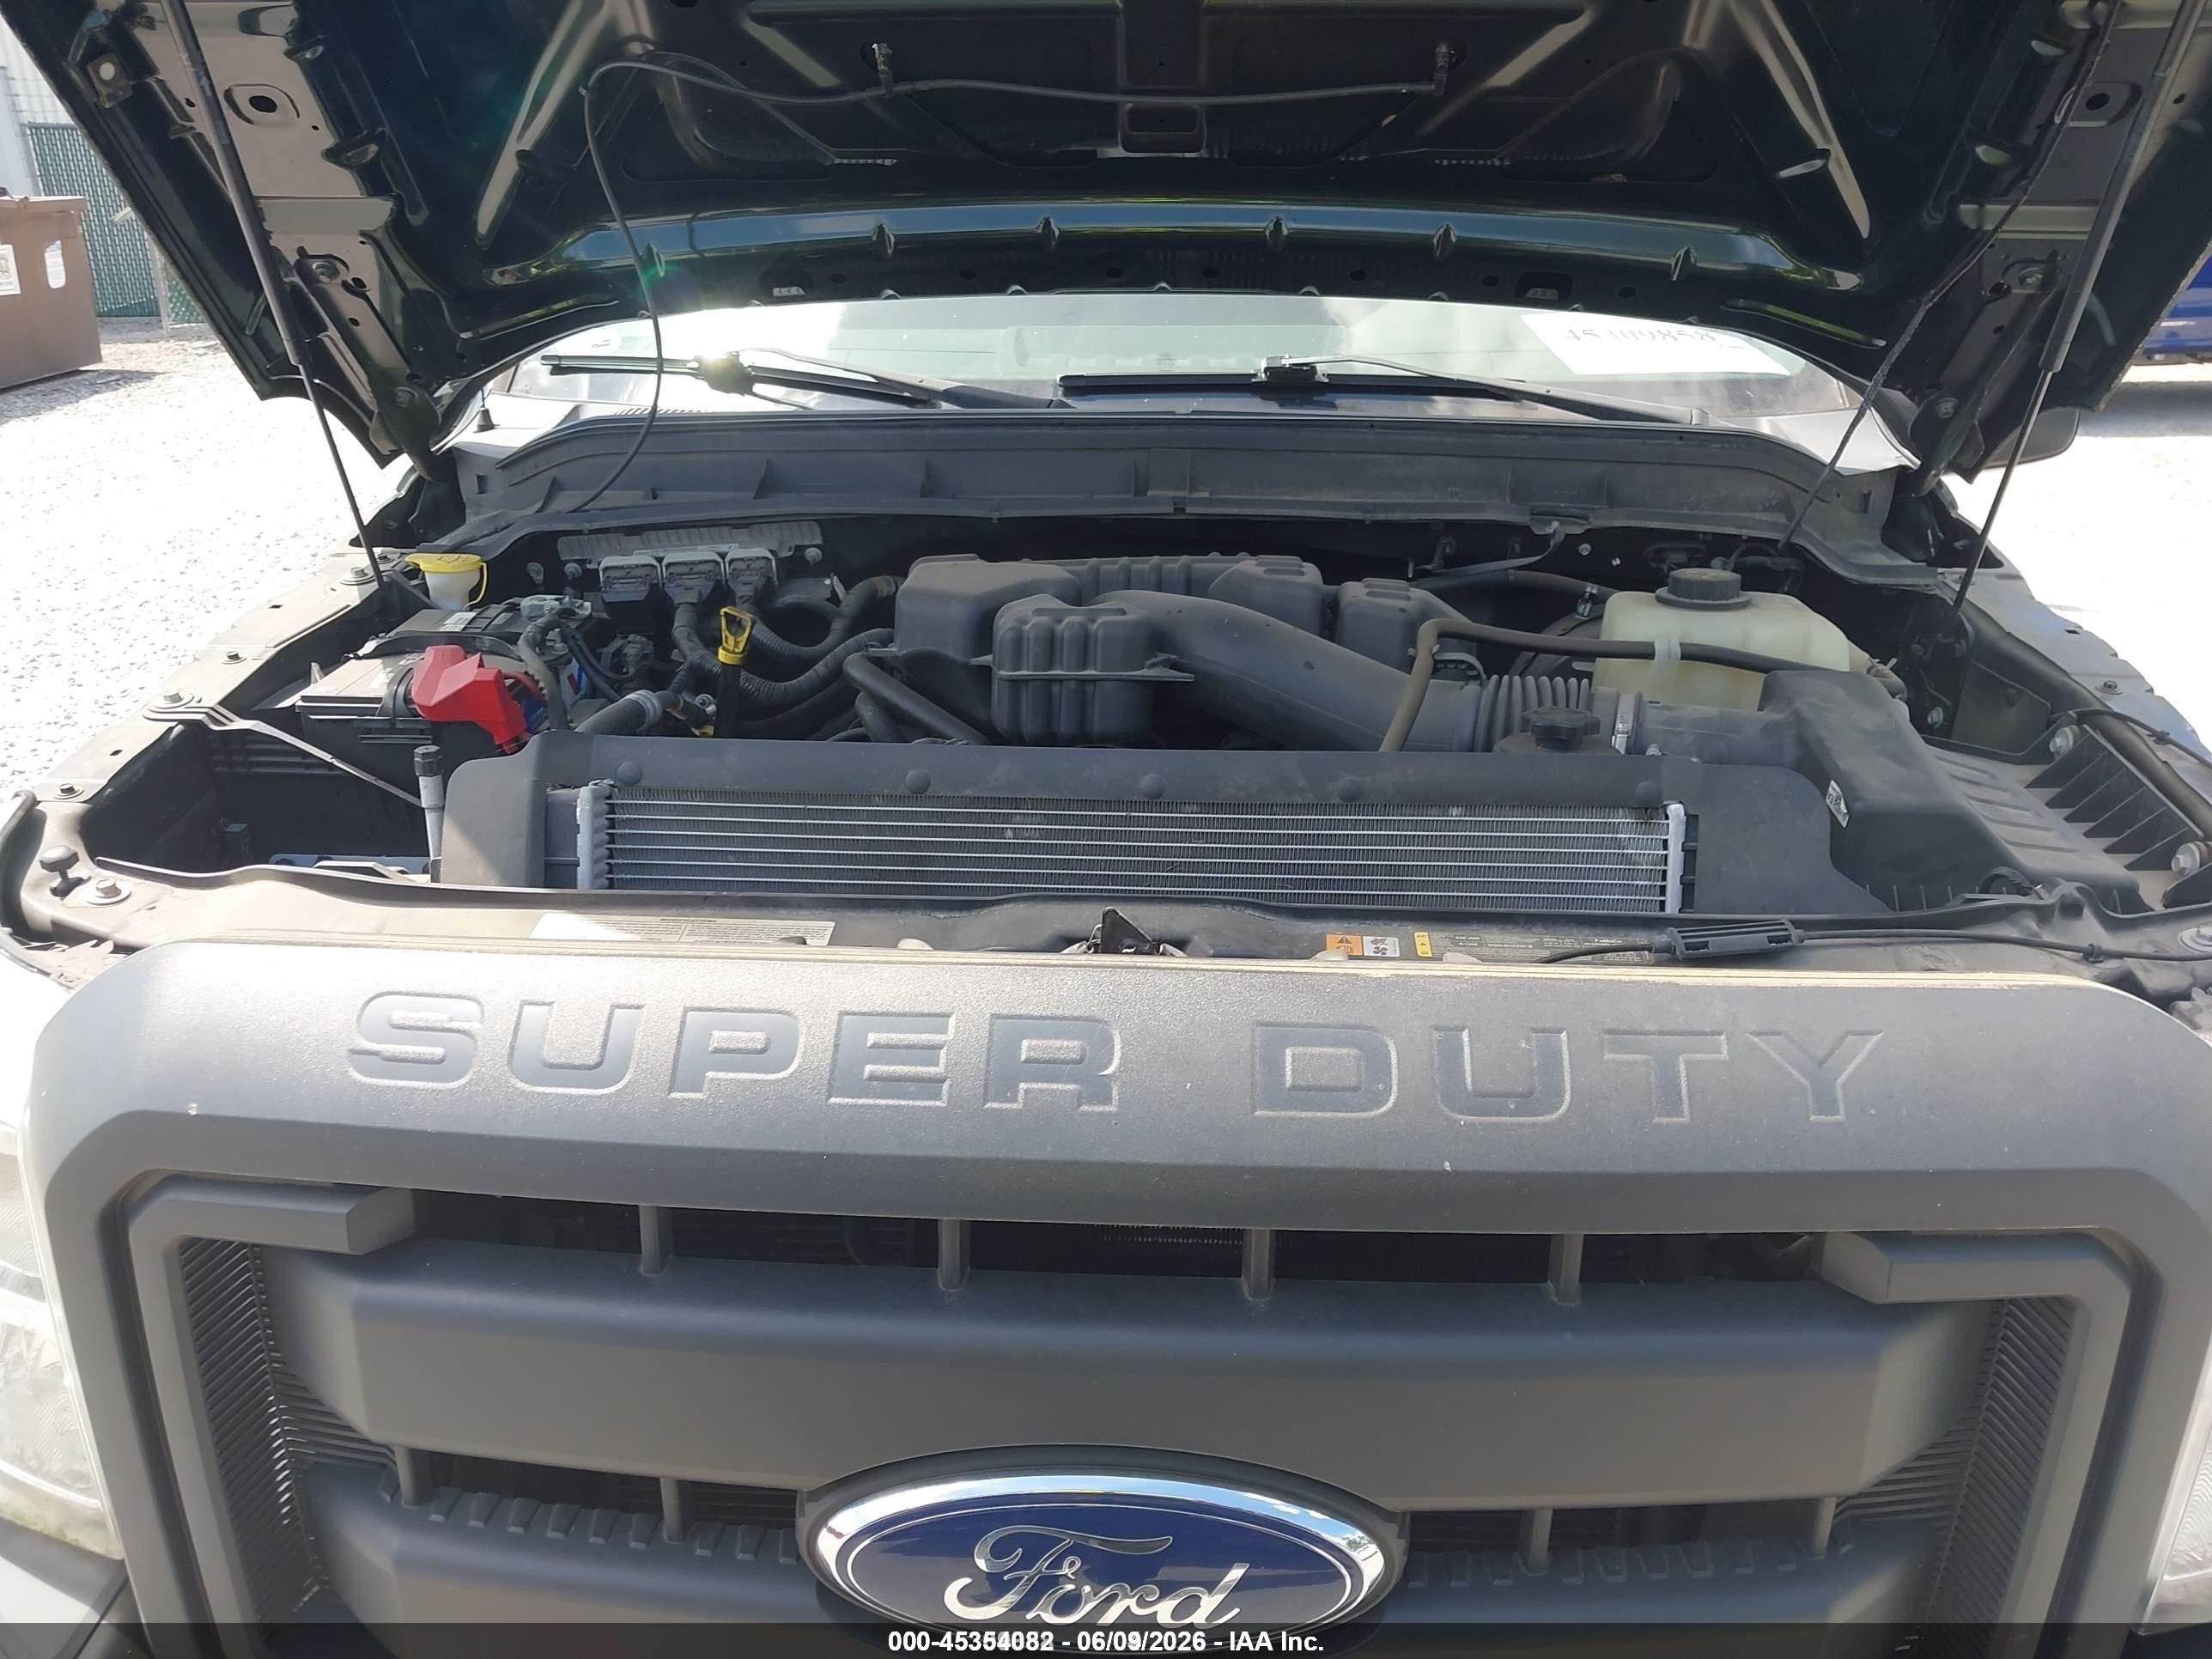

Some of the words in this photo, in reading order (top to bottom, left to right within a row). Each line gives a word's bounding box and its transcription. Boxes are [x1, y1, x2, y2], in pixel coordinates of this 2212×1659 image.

[348, 990, 1120, 1113] SUPER
[1252, 1023, 1884, 1122] DUTY
[944, 1524, 1250, 1630] Ford
